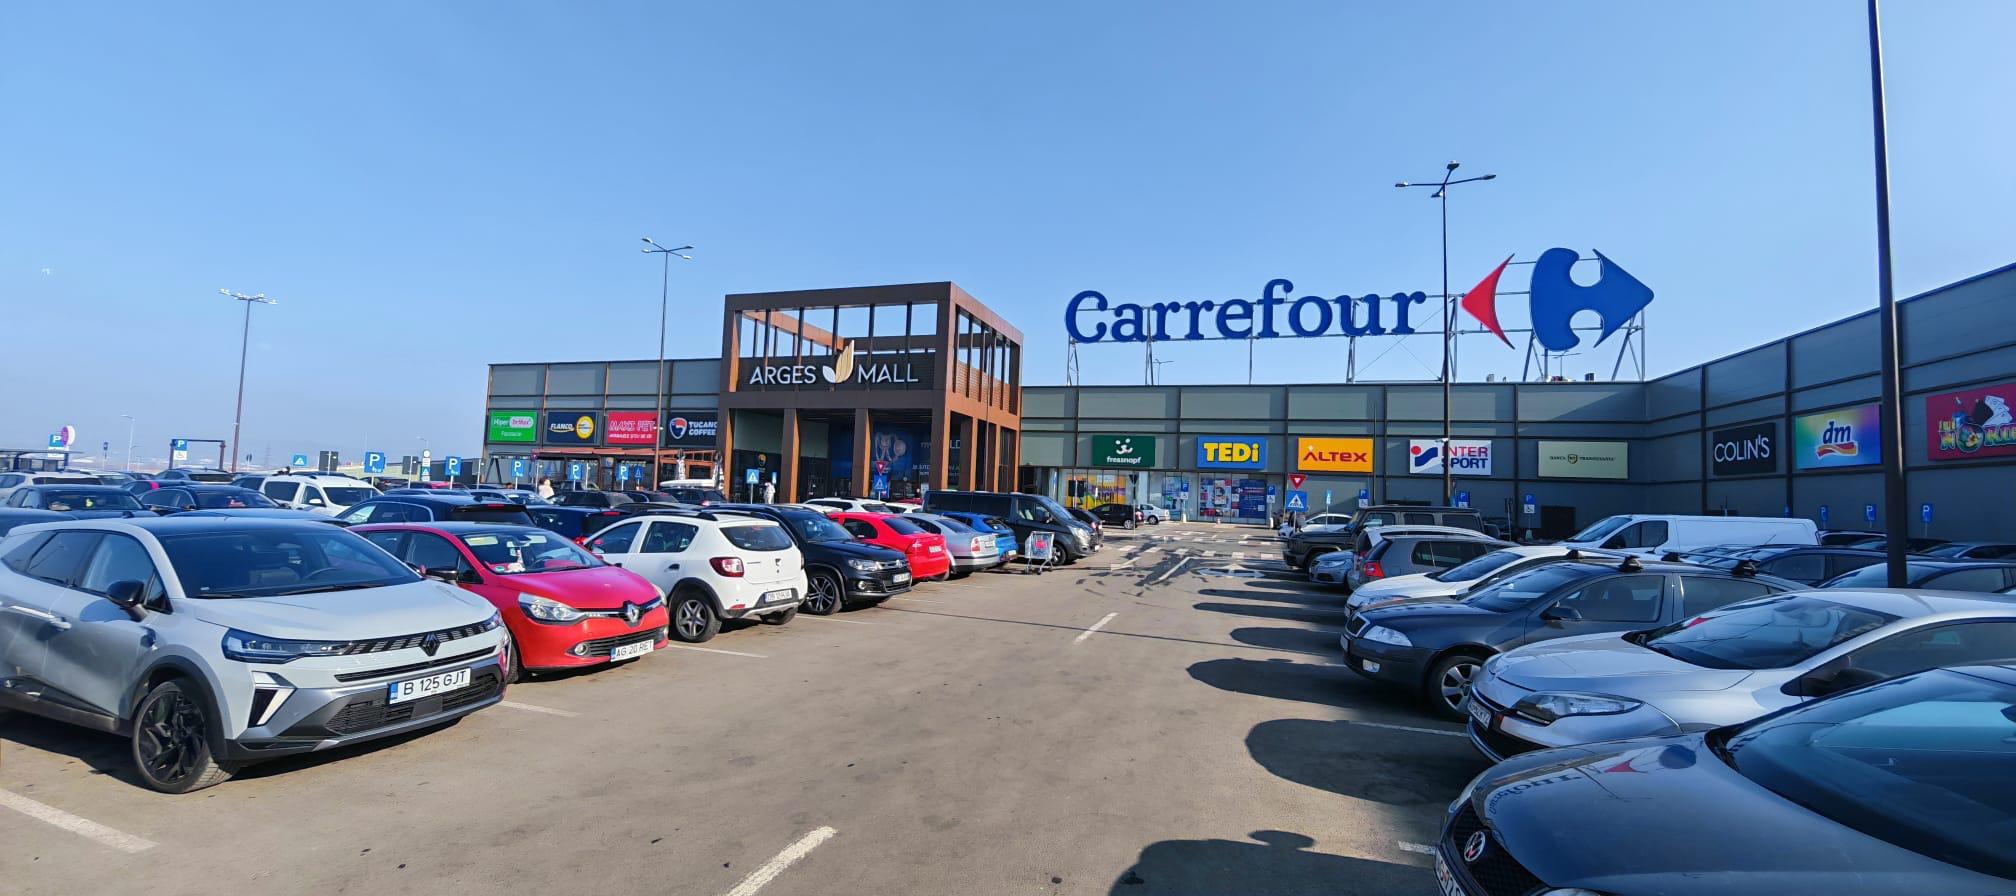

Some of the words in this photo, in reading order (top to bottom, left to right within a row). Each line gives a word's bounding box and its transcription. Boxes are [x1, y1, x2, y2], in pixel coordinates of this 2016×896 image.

[1065, 278, 1427, 344] Carrefour
[749, 365, 817, 385] ARGES
[857, 363, 919, 384] MALL
[1823, 420, 1851, 444] dm
[1714, 434, 1770, 462] COLIN'S
[369, 454, 380, 466] P
[448, 458, 458, 470] P
[513, 461, 522, 472] P
[403, 681, 415, 696] B
[420, 676, 440, 692] 125
[443, 670, 467, 686] GJT
